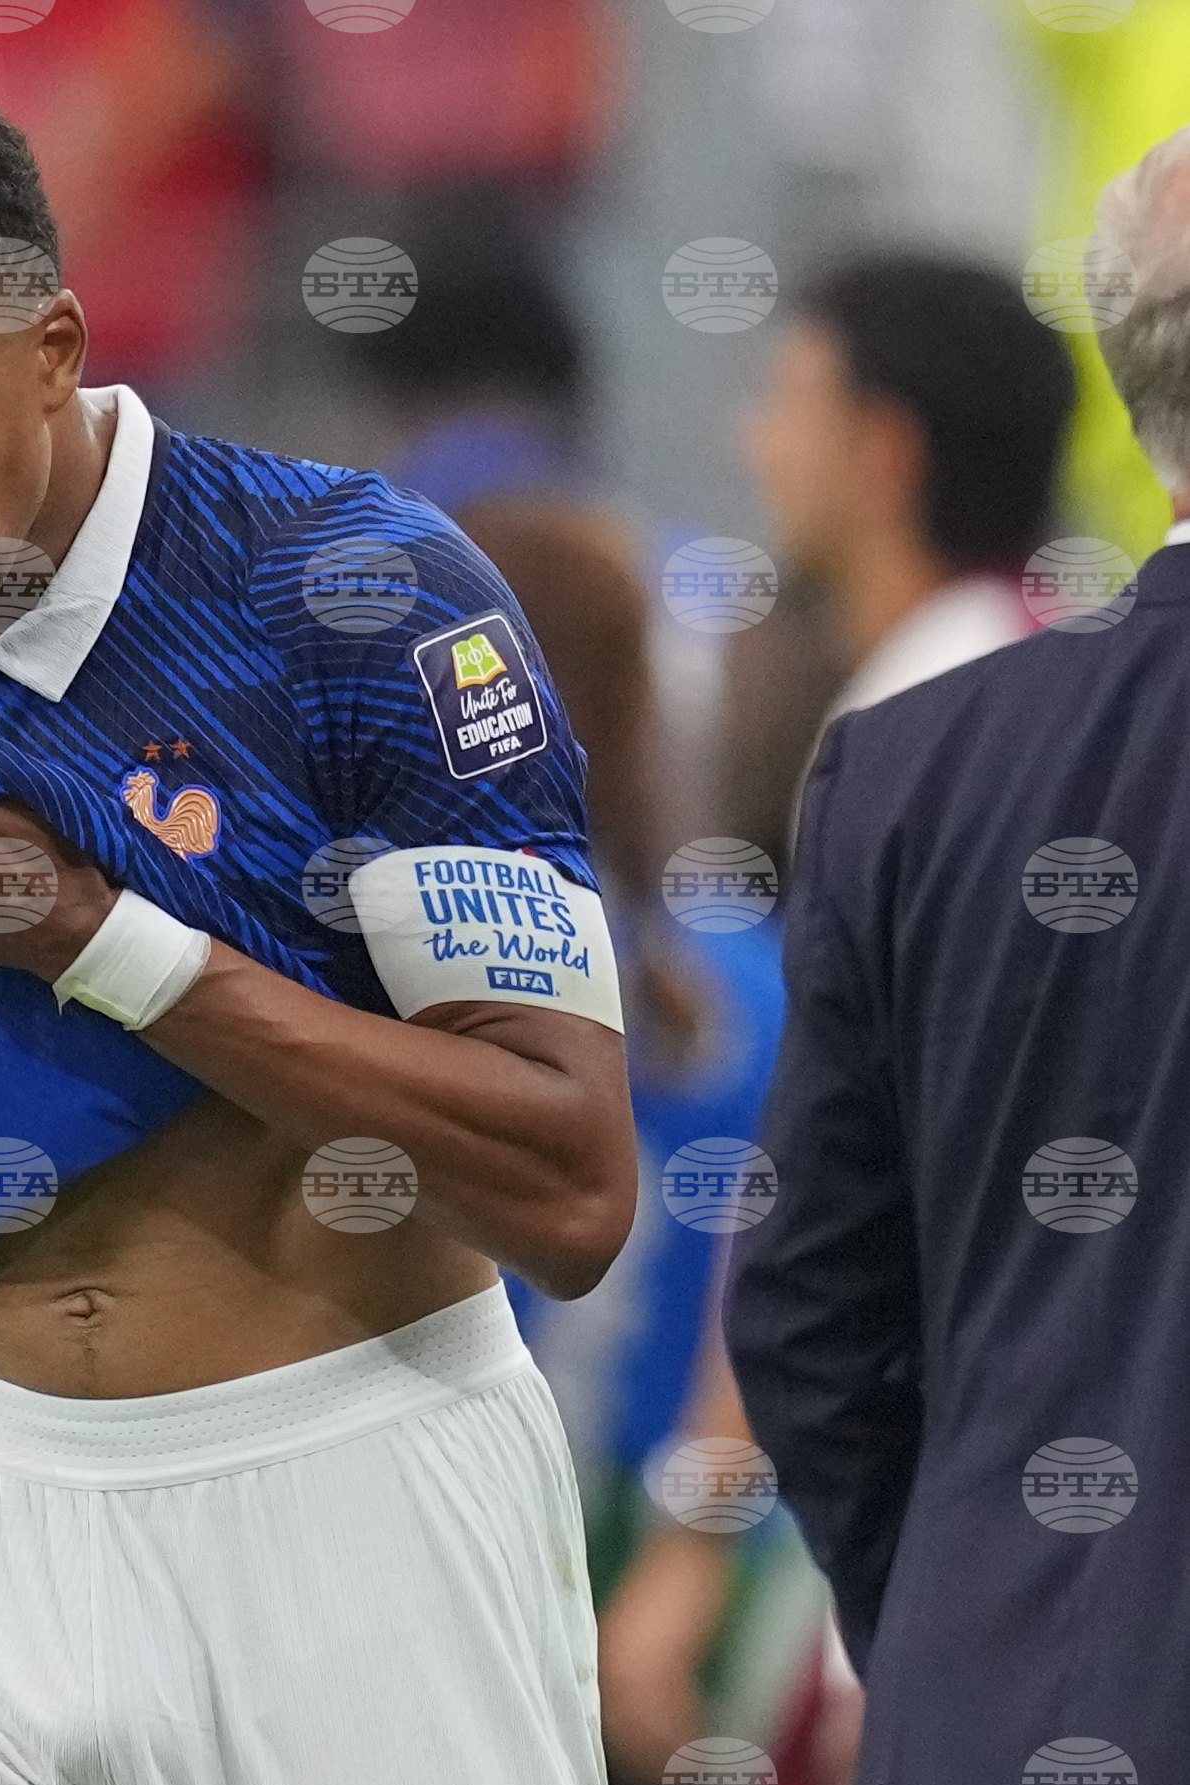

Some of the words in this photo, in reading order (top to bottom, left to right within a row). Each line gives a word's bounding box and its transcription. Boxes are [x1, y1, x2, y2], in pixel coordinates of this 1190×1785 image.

[460, 686, 500, 720] Unite
[495, 677, 517, 706] For
[456, 702, 534, 750] EDUCATION
[489, 735, 523, 757] FIFA
[414, 860, 566, 900] FOOTBALL
[420, 889, 576, 937] UNITES
[423, 929, 490, 962] the
[492, 929, 590, 979] World
[493, 970, 549, 992] FIFA
